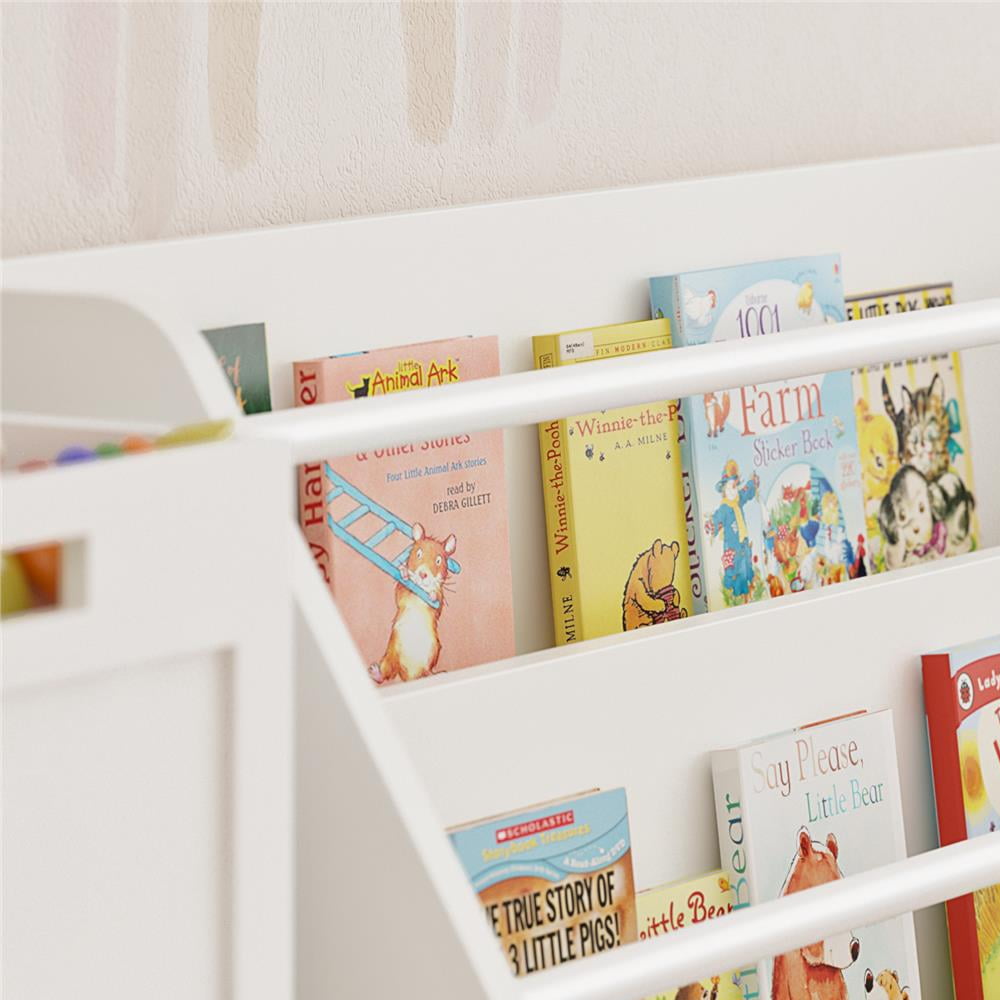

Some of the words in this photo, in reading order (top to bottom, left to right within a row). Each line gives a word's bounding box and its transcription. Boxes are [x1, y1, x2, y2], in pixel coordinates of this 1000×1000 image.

[736, 304, 781, 339] 1001
[614, 342, 647, 353] MODERN
[371, 366, 424, 396] Animal
[427, 360, 458, 387] Ark
[740, 381, 826, 437] Farm
[637, 432, 668, 446] MILNE
[752, 437, 799, 468] Sticker
[802, 428, 834, 455] Book
[387, 470, 403, 483] Four
[404, 467, 423, 480] Little
[424, 464, 449, 476] Animal
[451, 461, 463, 472] Ark
[464, 457, 488, 470] stories
[447, 483, 465, 496] read
[466, 481, 477, 494] by
[545, 421, 570, 555] Winnie-the-Pooh
[432, 499, 459, 514] DEBRA
[461, 493, 491, 512] GILLETT
[562, 594, 578, 644] MILNE
[751, 751, 792, 798] Say
[795, 736, 864, 782] Please,
[805, 784, 848, 823] Little
[850, 779, 884, 810] Bear
[506, 812, 574, 838] SCHOLASTIC
[502, 892, 543, 935] TRUE
[545, 877, 593, 923] STORY
[596, 870, 616, 908] OF
[639, 901, 685, 941] ittle
[523, 927, 576, 974] LITTLE
[579, 912, 621, 957] PIGS!
